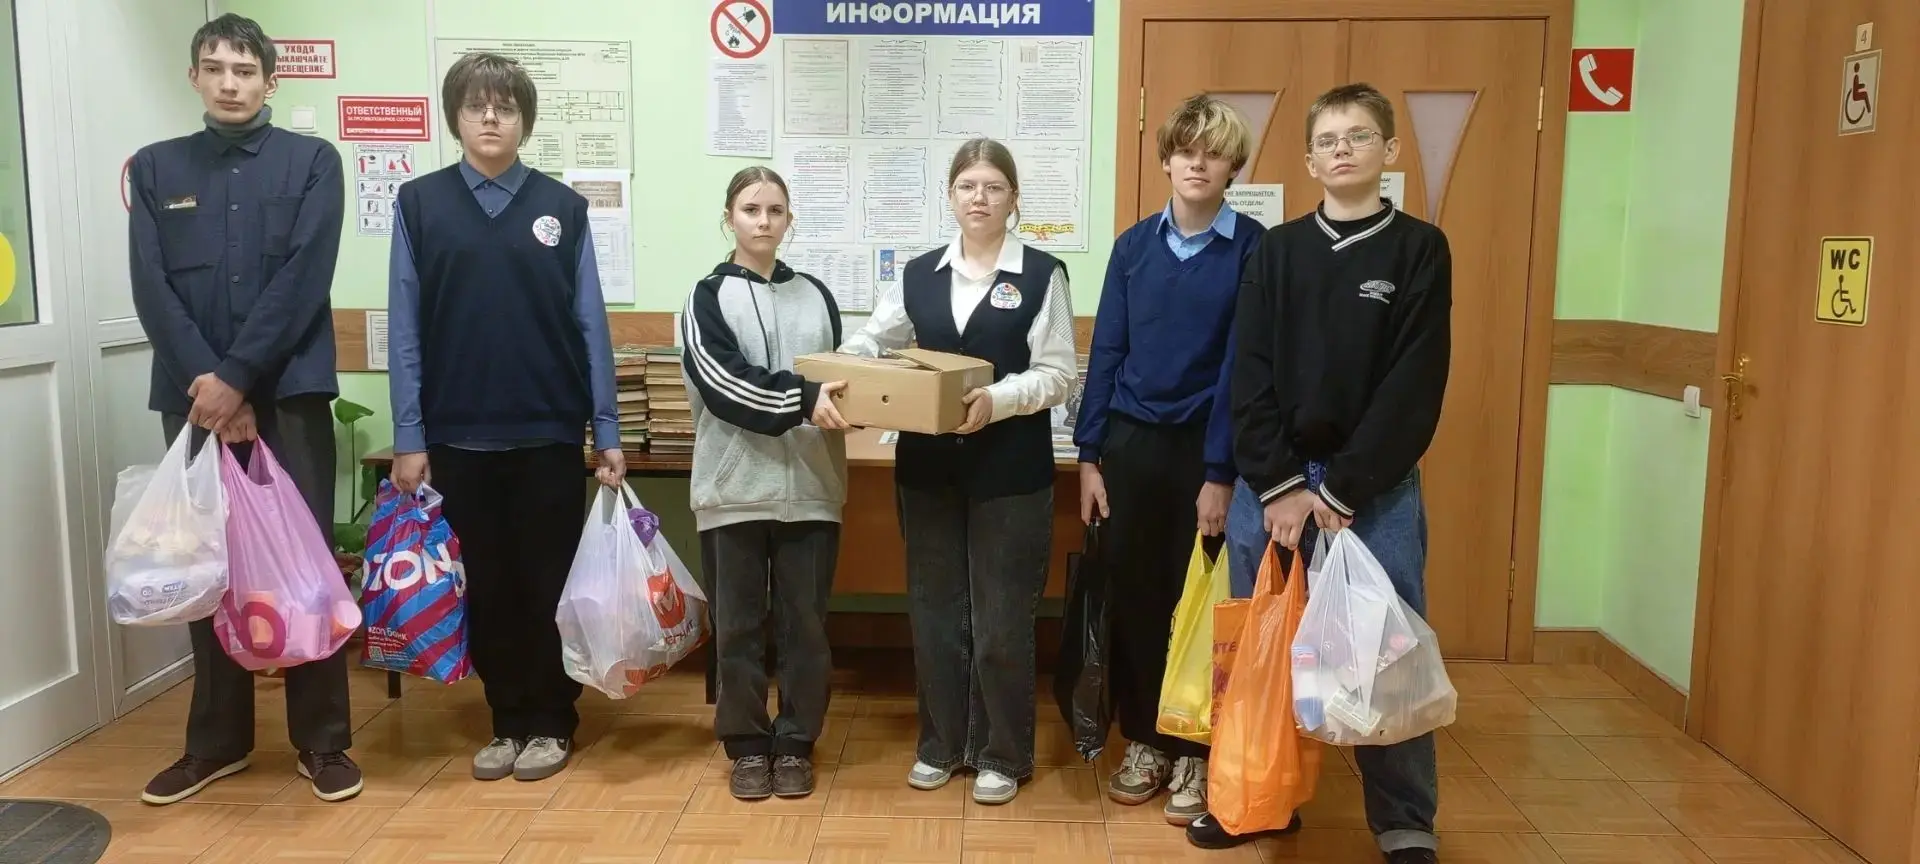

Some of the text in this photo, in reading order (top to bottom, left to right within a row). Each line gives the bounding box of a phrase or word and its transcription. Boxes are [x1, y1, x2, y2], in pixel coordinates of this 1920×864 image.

[826, 2, 1041, 28] ИНФОРМАЦИЯ
[1860, 30, 1868, 44] 4
[284, 45, 315, 54] УХОДЯ
[276, 55, 328, 63] ЫКЛЮЧАЙТЕ
[276, 64, 325, 73] ОСВЕЩЕНИЕ
[346, 105, 422, 116] ОТВЕТСТВЕННЫЙ
[1830, 249, 1861, 270] WC
